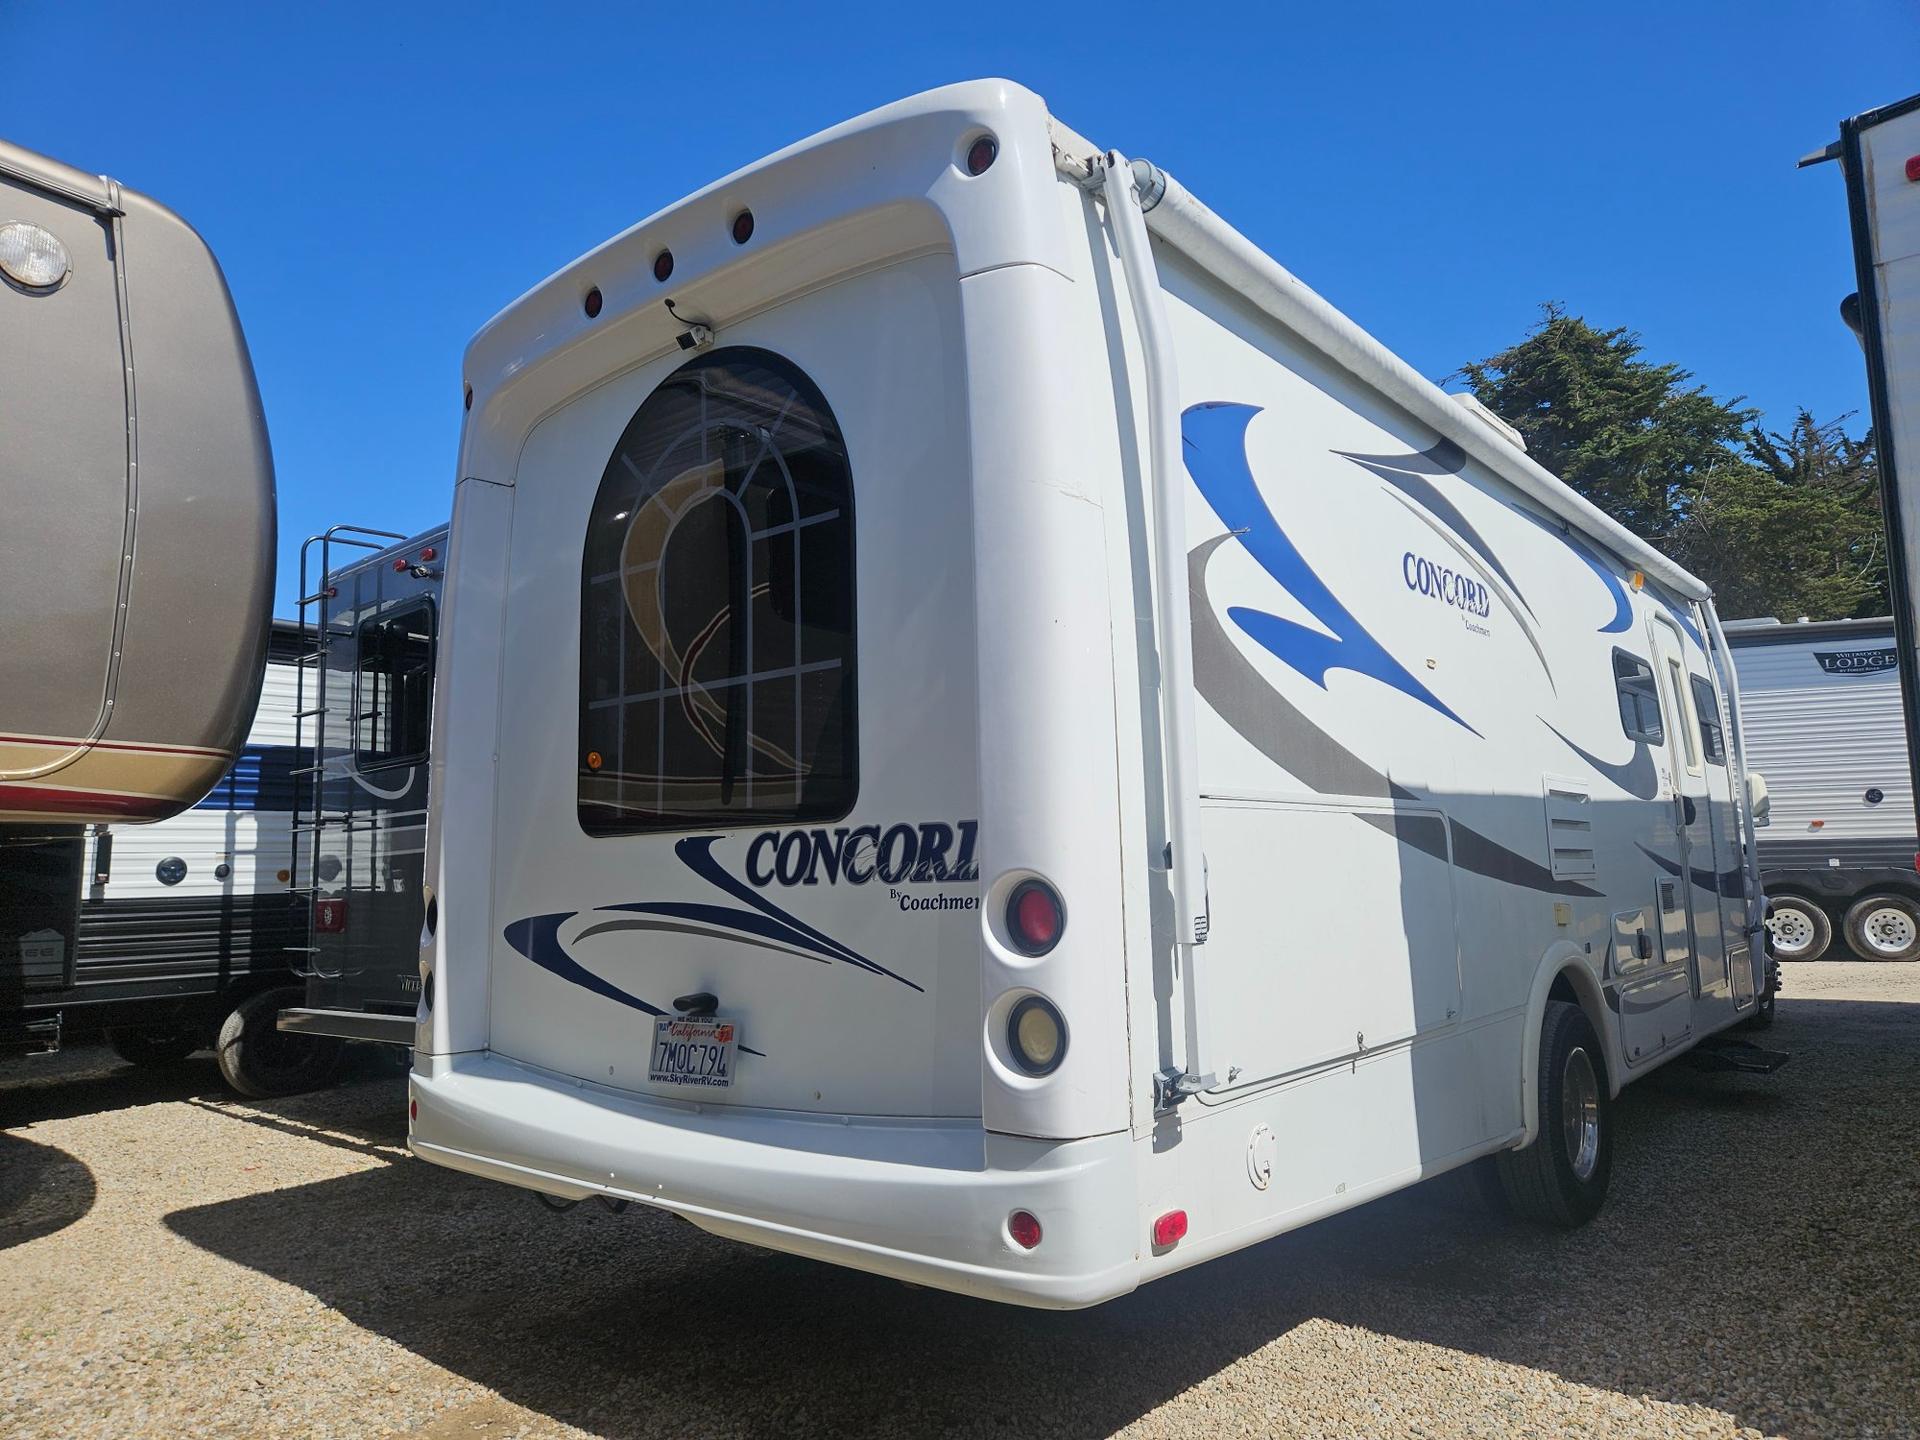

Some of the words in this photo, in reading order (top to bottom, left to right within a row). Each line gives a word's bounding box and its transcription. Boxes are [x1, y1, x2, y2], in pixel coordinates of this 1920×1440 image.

[1403, 552, 1489, 618] CONCORD
[1825, 655, 1896, 669] LODGE
[890, 888, 901, 902] By
[658, 1042, 727, 1076] 7MQC794
[650, 1073, 729, 1087] www.SkyRiverRV.com
